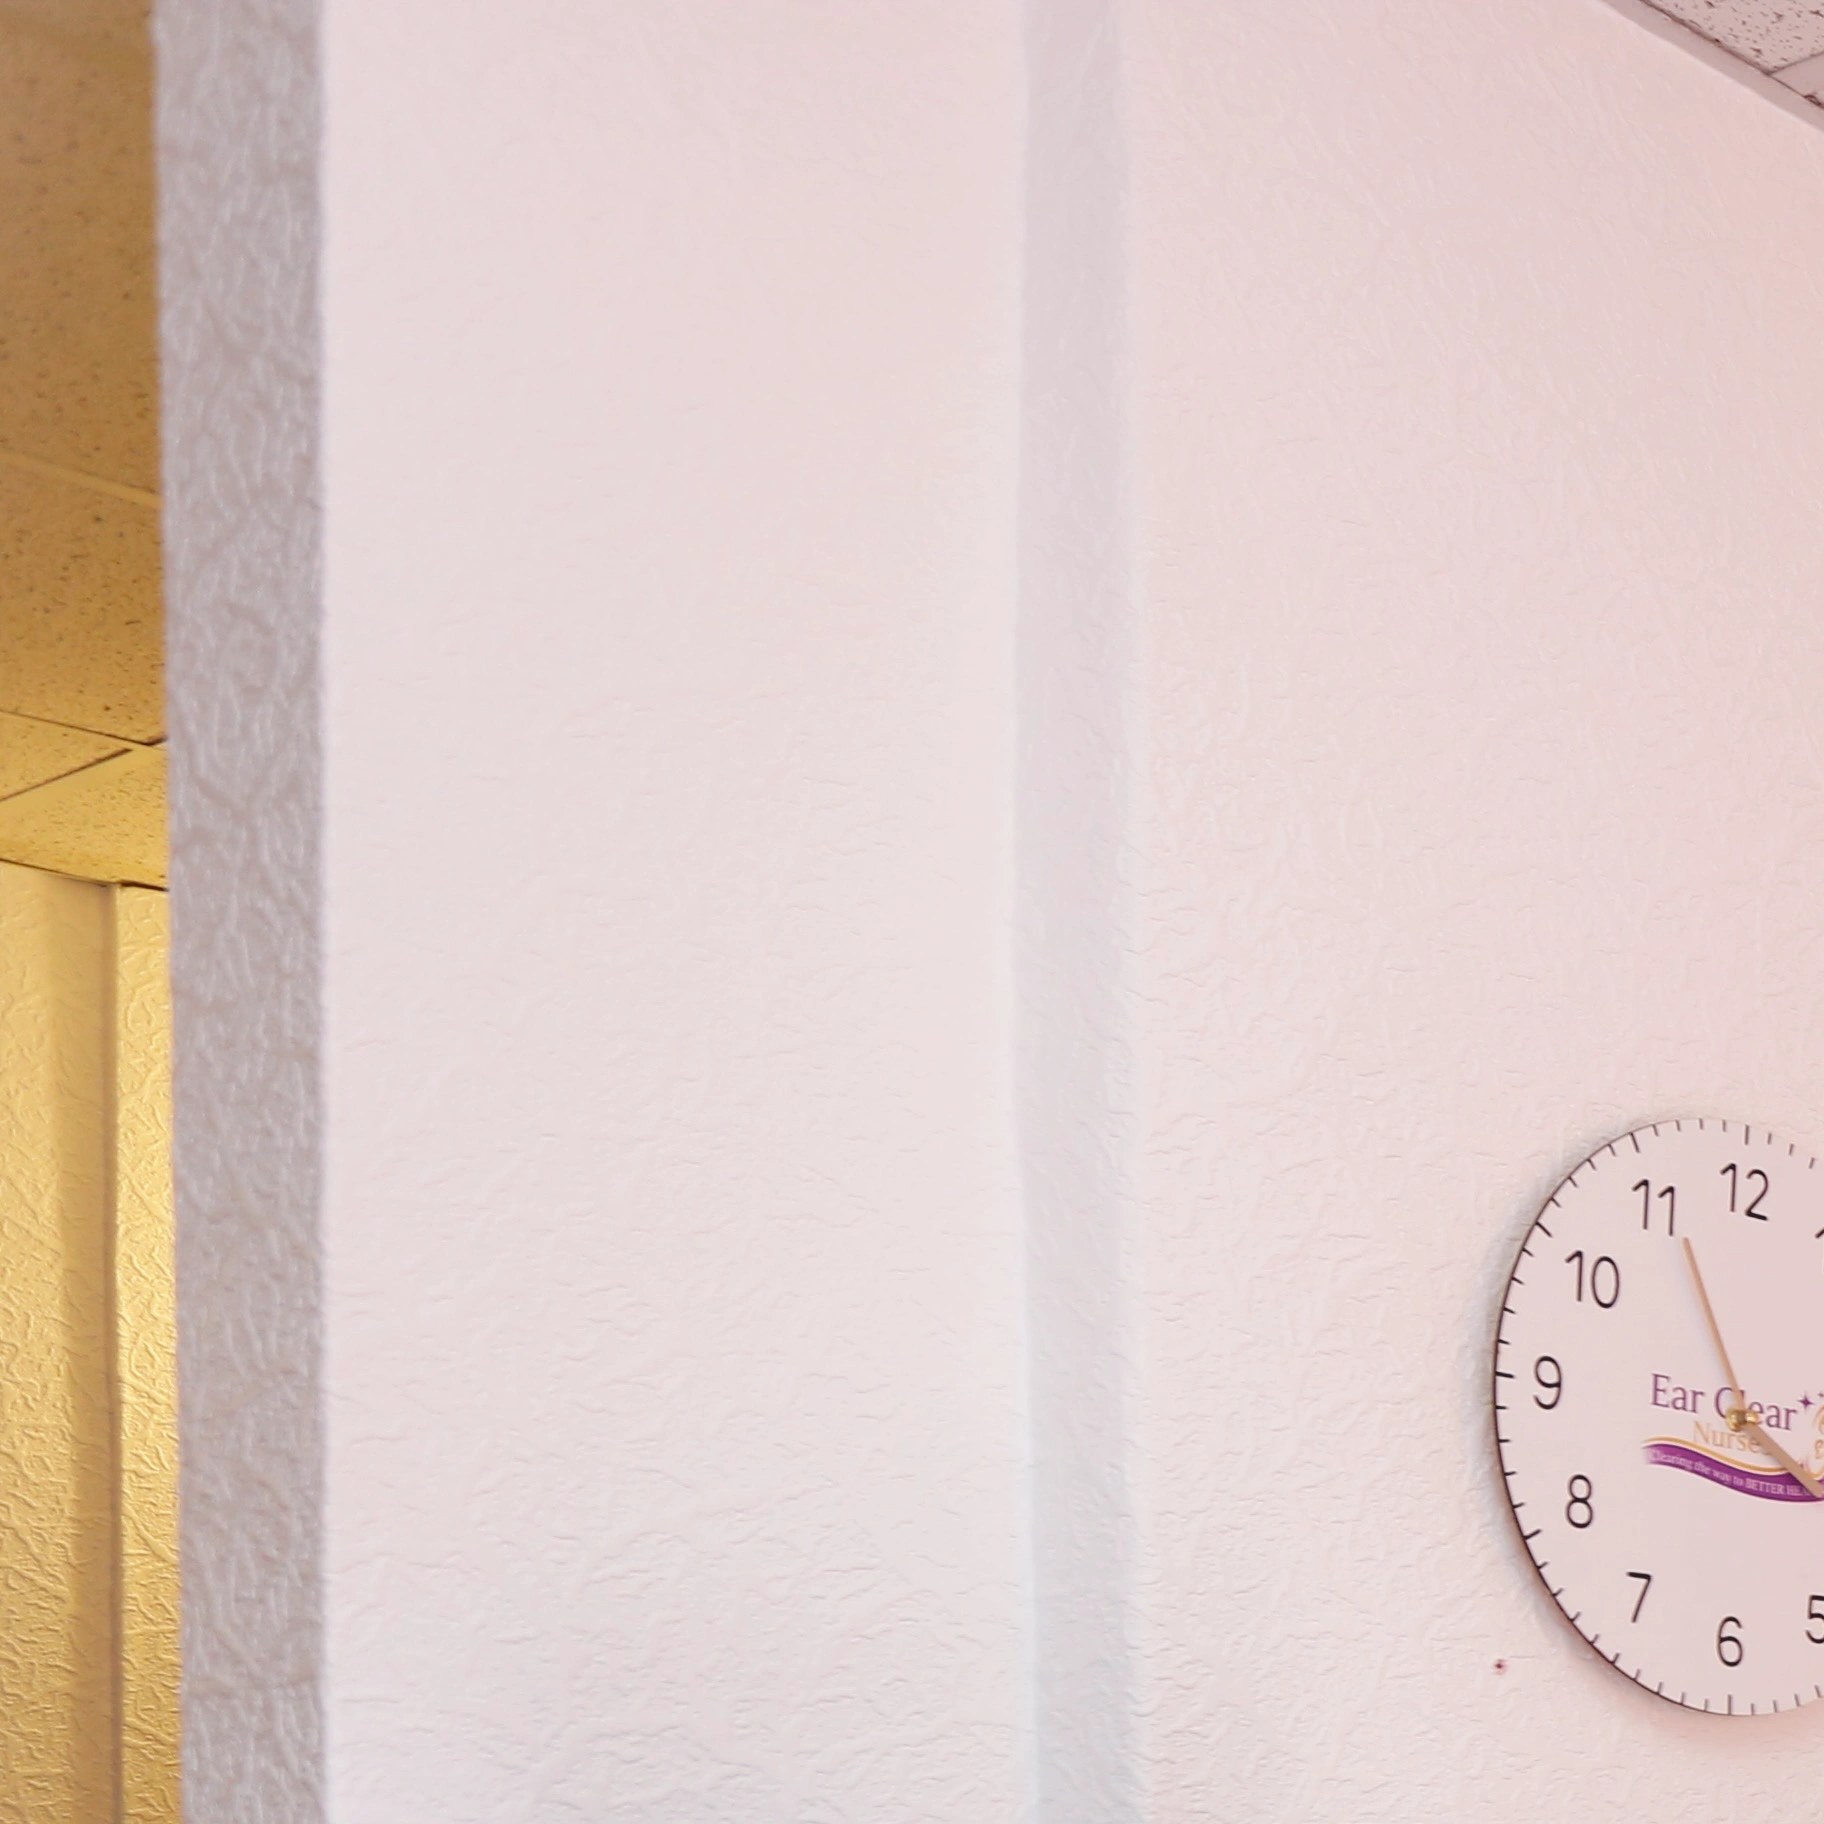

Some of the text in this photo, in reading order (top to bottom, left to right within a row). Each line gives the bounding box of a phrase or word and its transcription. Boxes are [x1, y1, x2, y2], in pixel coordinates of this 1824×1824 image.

[1631, 1178, 1676, 1236] 11
[1719, 1162, 1770, 1221] 12
[1565, 1250, 1620, 1309] 10
[1533, 1355, 1562, 1410] 9
[1651, 1373, 1705, 1413] Ear
[1693, 1420, 1773, 1456] Nurse
[1565, 1474, 1594, 1528] 8
[1625, 1572, 1652, 1623] 7
[1716, 1616, 1743, 1667] 6
